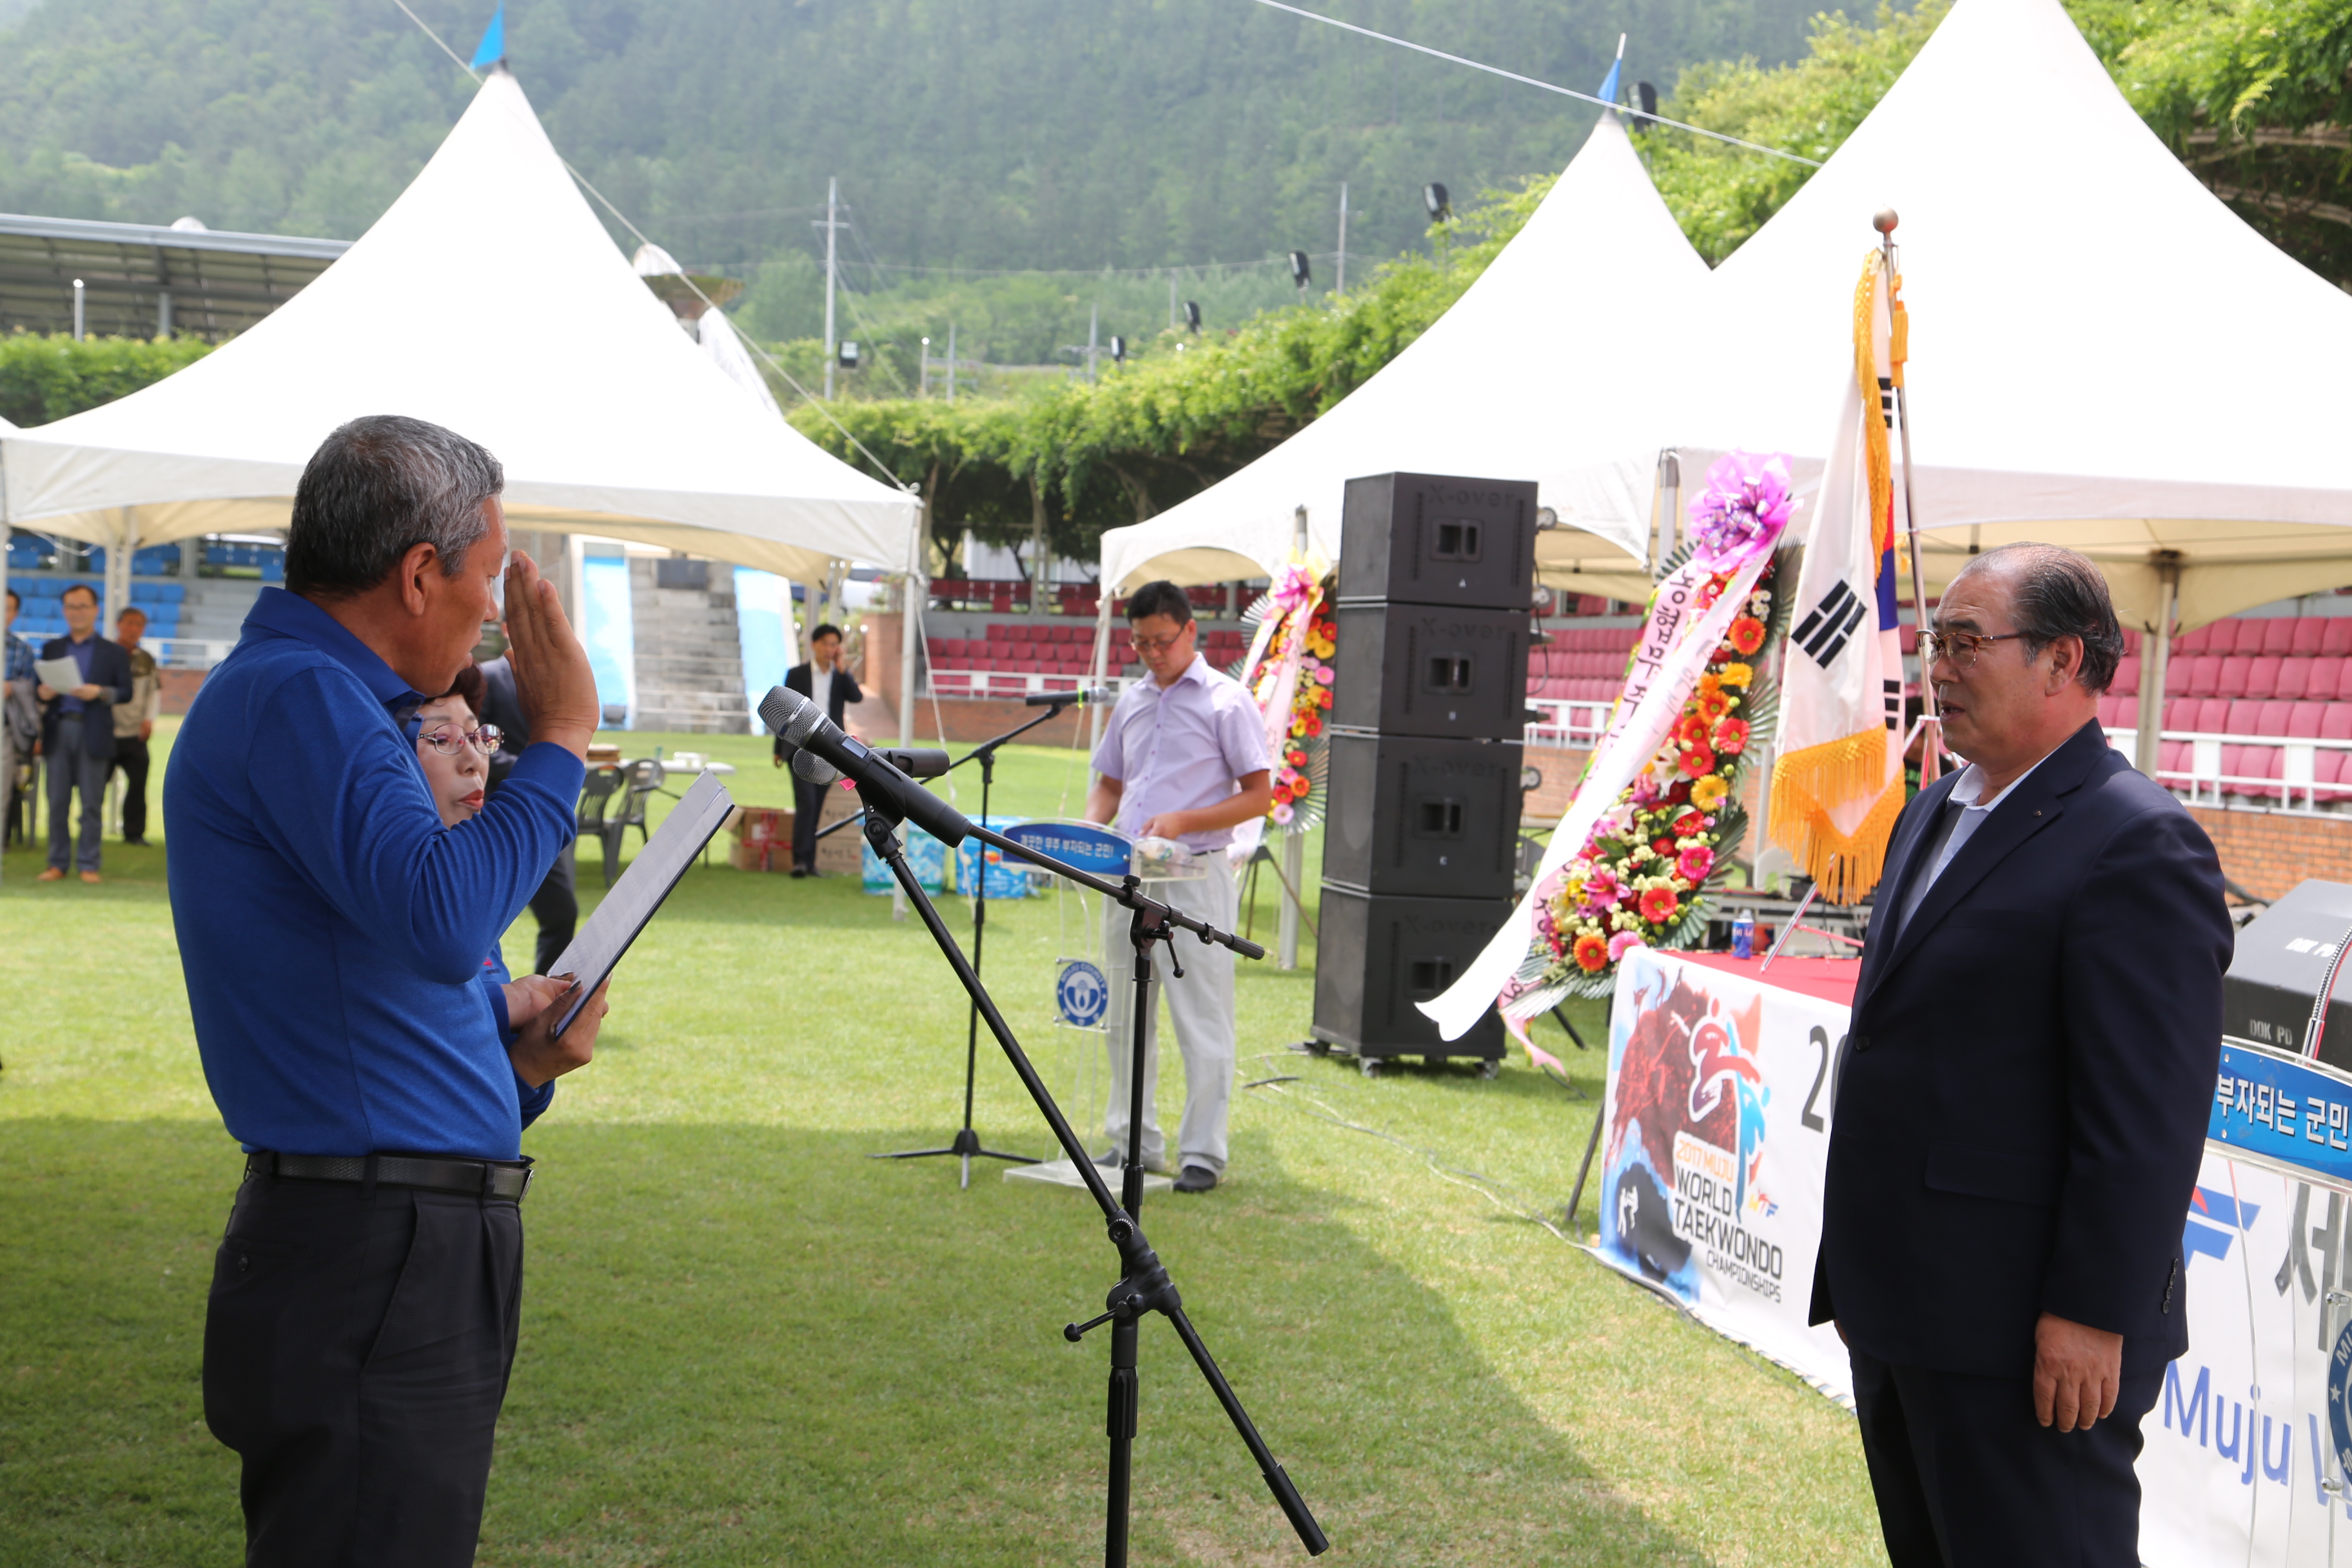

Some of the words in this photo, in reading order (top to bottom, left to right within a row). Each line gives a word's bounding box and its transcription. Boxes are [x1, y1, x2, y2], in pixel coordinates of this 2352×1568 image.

[2217, 1073, 2296, 1136] 부자되는
[2306, 1096, 2349, 1151] 군민
[1676, 1164, 1732, 1217] WORLD
[1677, 1139, 1703, 1168] 2017
[1704, 1152, 1734, 1182] MUJU
[1674, 1198, 1782, 1280] TAEKWONDO
[1706, 1250, 1781, 1304] CHAMPIONSHIPS
[2164, 1360, 2292, 1486] Muju
